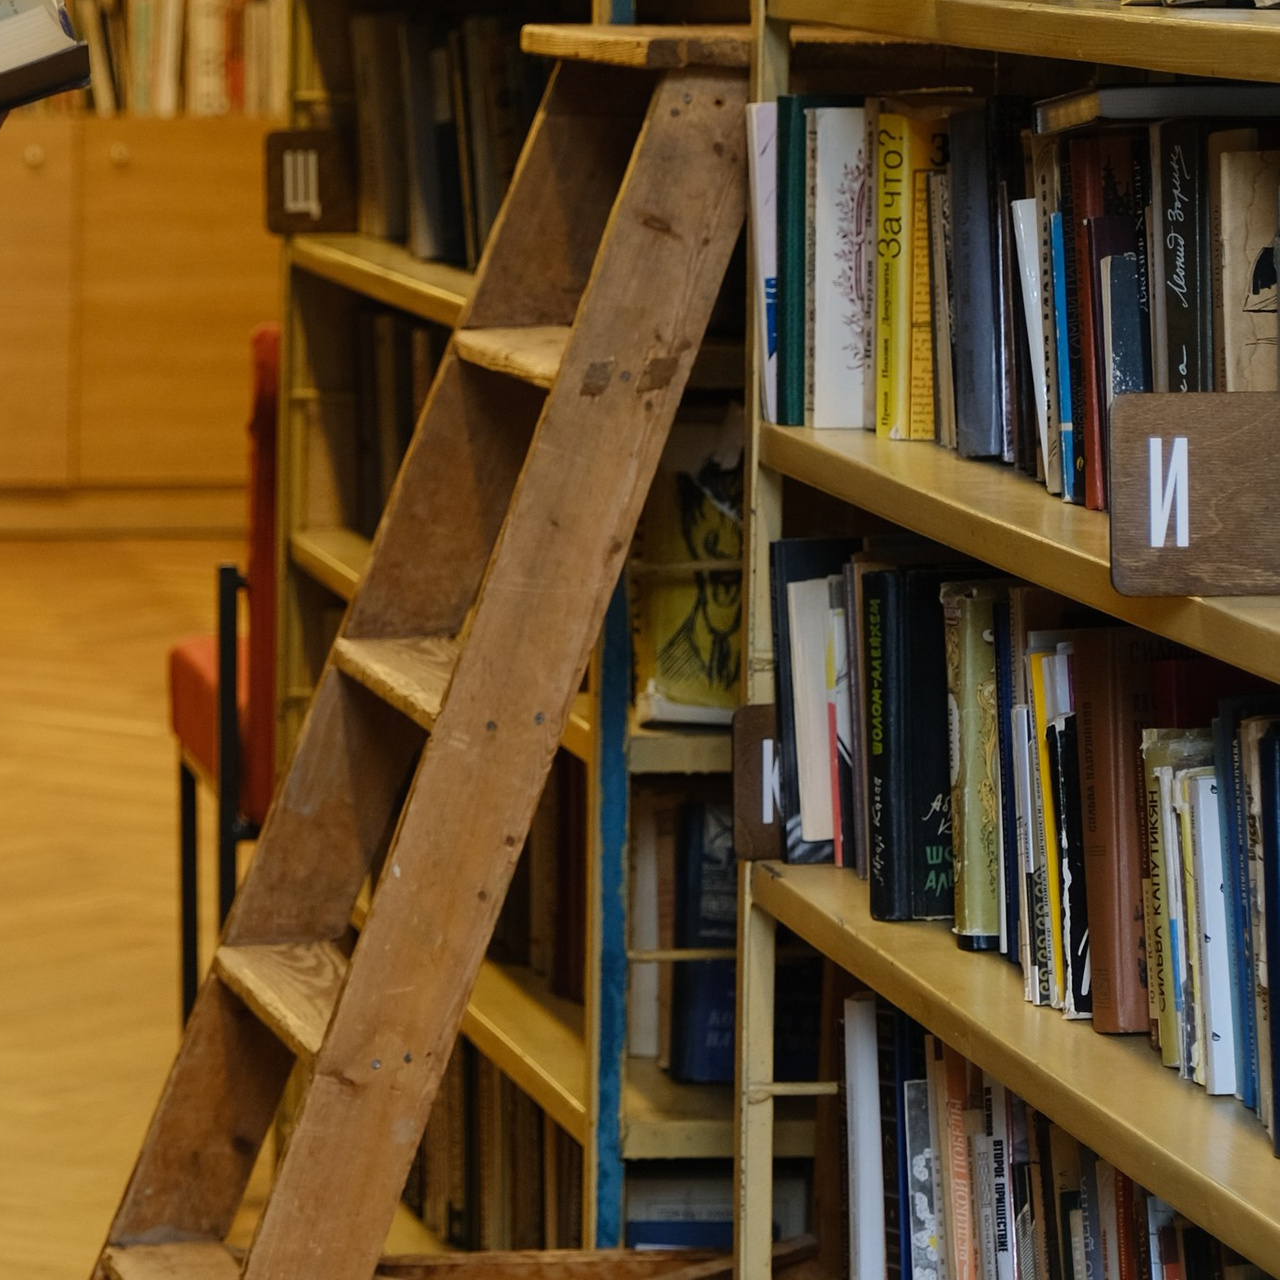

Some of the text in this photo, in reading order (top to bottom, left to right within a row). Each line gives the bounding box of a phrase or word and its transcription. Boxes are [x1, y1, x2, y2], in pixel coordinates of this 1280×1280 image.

[283, 149, 323, 221] Щ
[877, 128, 904, 208] что?
[1166, 145, 1190, 223] Зорин
[877, 216, 902, 259] За
[1165, 225, 1189, 309] Леонид
[879, 262, 892, 326] Документы
[1068, 295, 1082, 359] САМЫЙ
[1149, 436, 1190, 548] И
[868, 598, 883, 756] ШОЛОМ-АЛЕЙХЕМ
[762, 737, 785, 825] К
[1040, 864, 1049, 907] ПОИСКАХ
[1147, 790, 1167, 1013] СИЛЬВА КАПУТИКЯН
[1238, 852, 1247, 906] ЗАПИСКИ
[949, 1098, 970, 1263] ВЕЛИКОЙ ПОБЕДЫ
[992, 1139, 1009, 1253] ВТОРОЕ ПРИШЕСТВИЕ
[1080, 1176, 1095, 1253] ЦЕНТРА
[983, 1214, 993, 1266] КОГИНОВ
